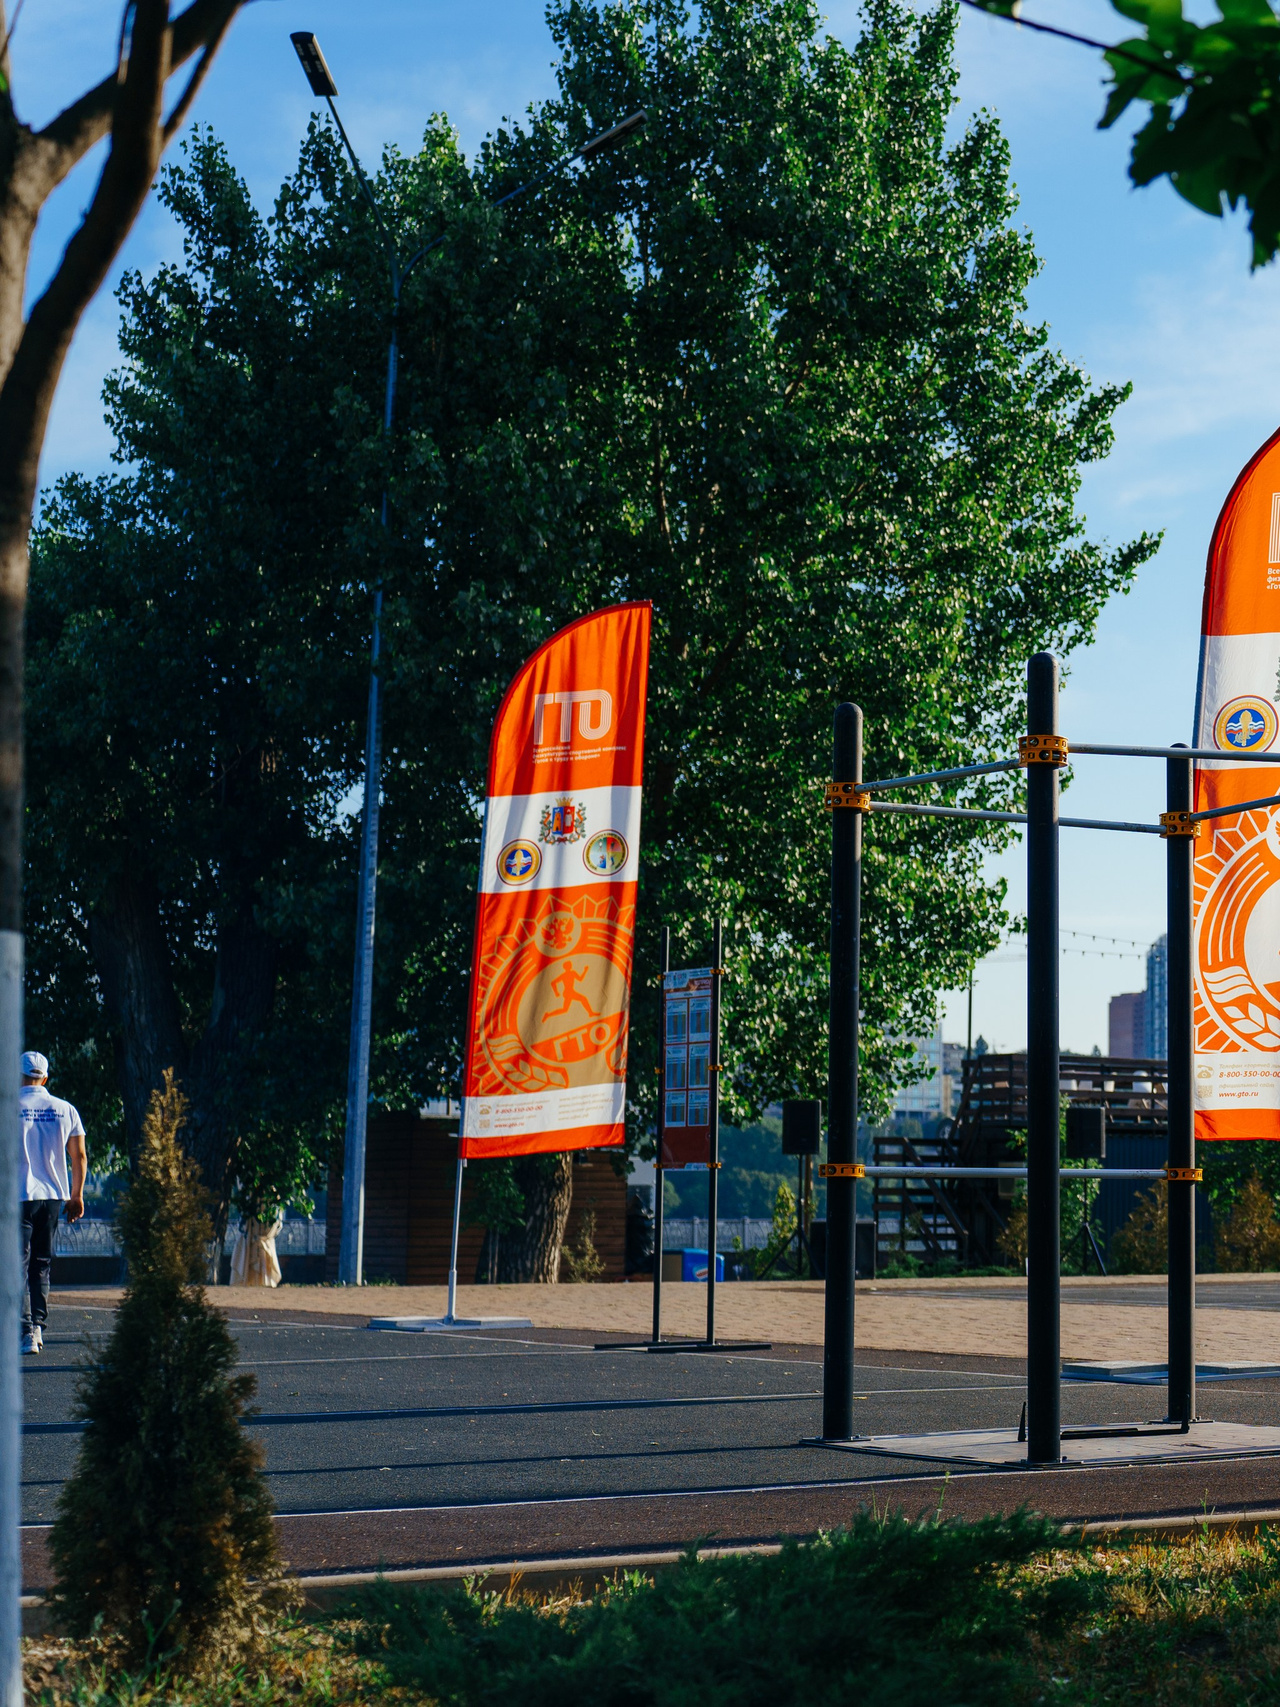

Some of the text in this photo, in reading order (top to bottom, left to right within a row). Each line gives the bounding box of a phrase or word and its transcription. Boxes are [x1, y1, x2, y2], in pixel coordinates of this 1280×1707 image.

[533, 689, 613, 745] ГТО
[552, 1022, 611, 1062] ГТО
[1218, 1091, 1259, 1099] www.gto.ru
